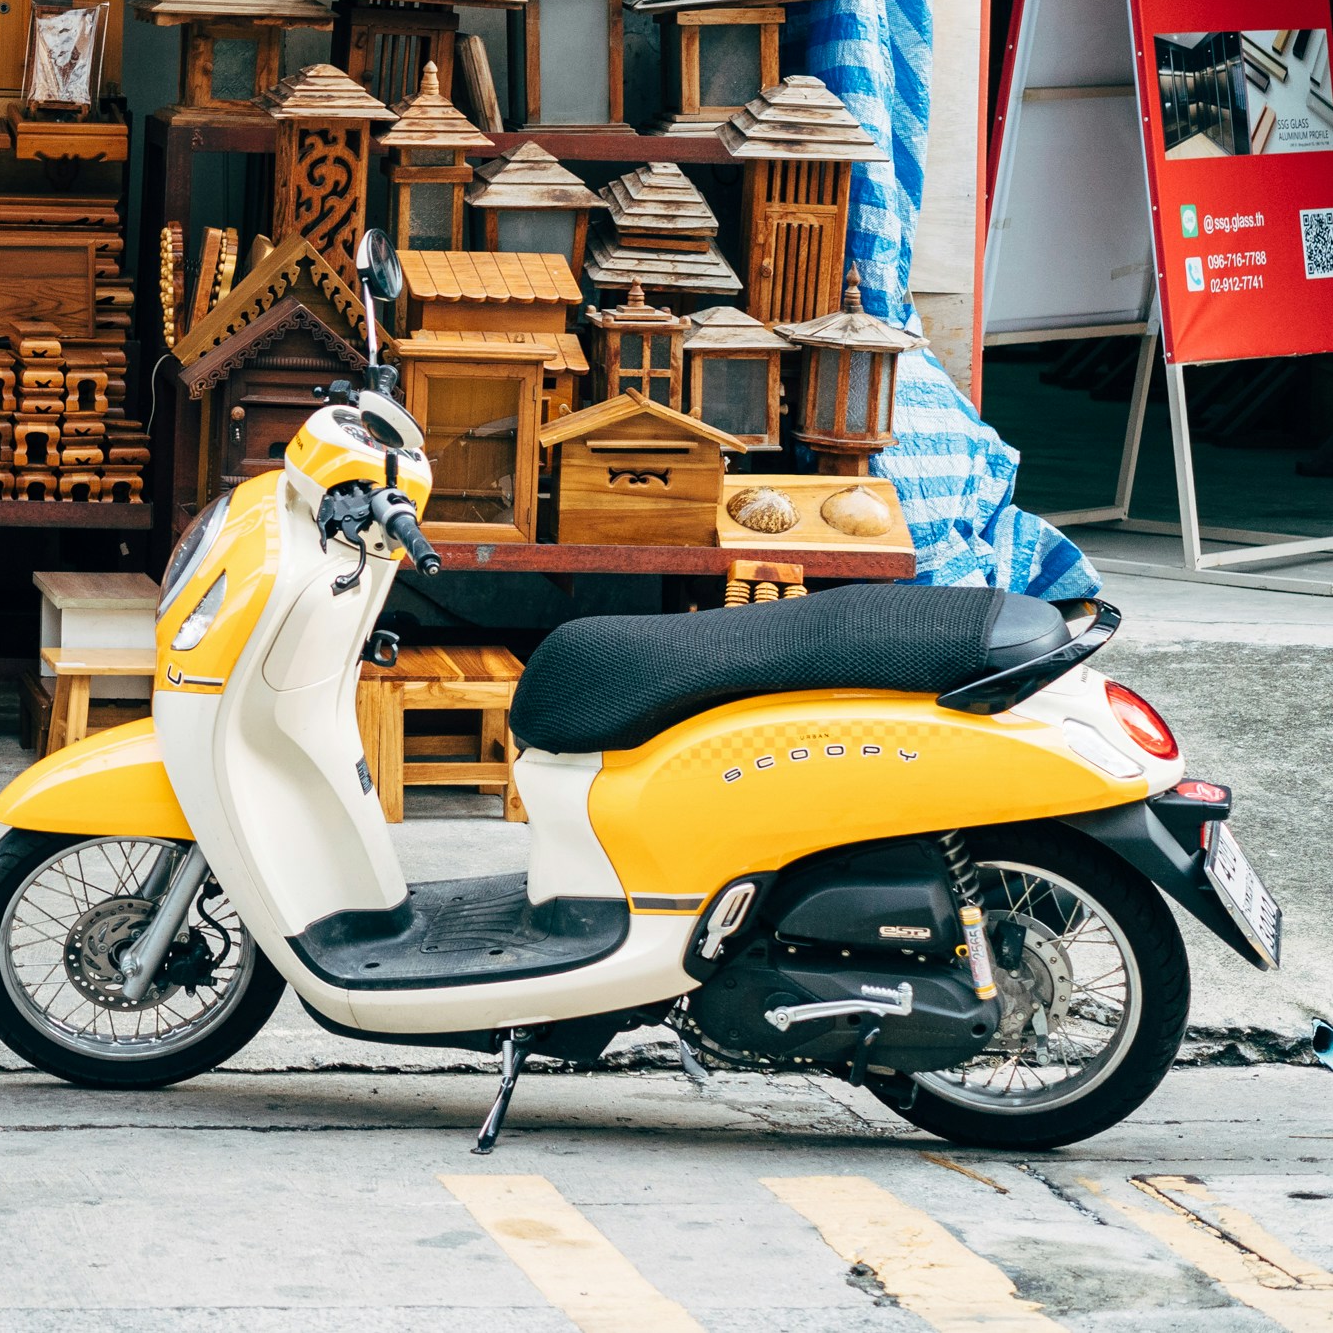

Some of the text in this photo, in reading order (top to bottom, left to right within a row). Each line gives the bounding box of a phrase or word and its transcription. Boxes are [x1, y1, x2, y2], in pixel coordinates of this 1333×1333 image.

[1277, 117, 1309, 130] SSG GLASS
[1309, 129, 1329, 141] PROFILE
[1207, 251, 1267, 269] 096-716-7788
[1210, 275, 1264, 294] 02-912-7741
[799, 733, 830, 741] URBAN
[723, 744, 918, 783] SCOOPY
[971, 928, 984, 962] 2565
